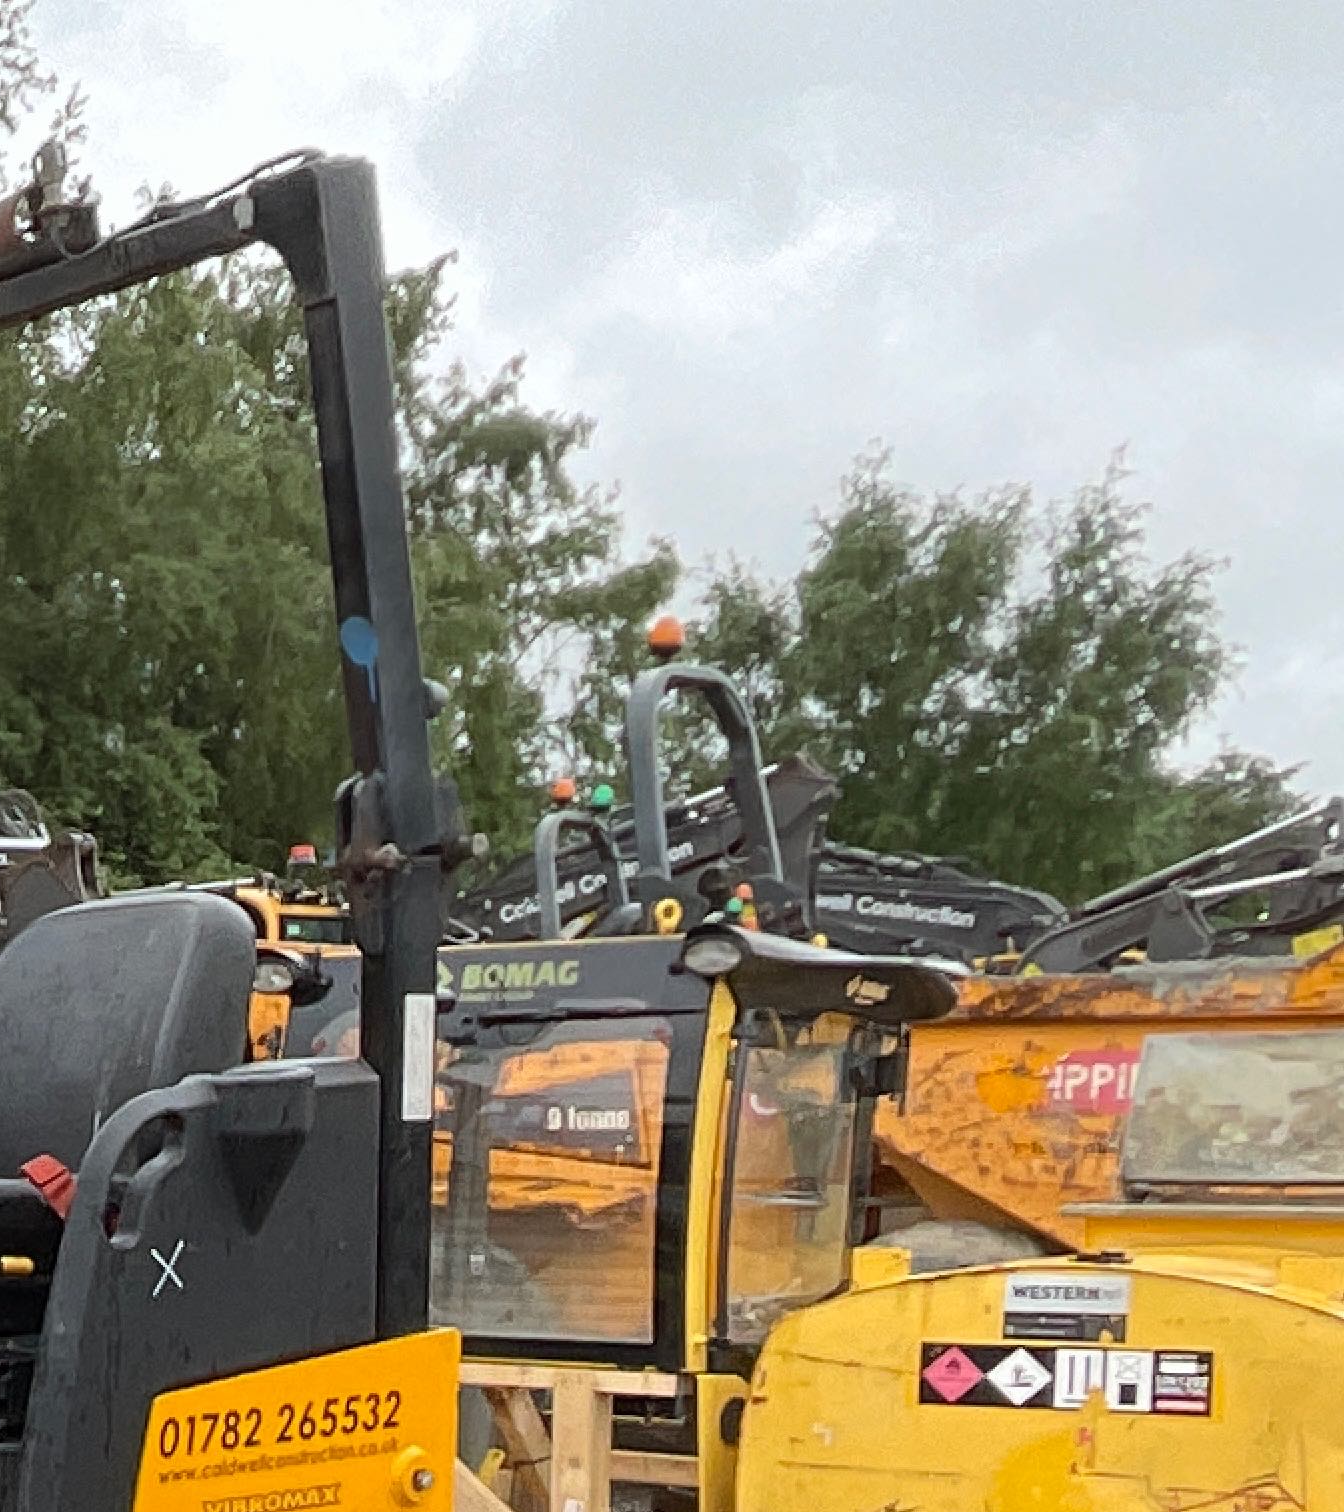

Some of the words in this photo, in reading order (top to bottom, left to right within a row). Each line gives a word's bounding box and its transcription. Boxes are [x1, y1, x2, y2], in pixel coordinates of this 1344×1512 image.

[460, 960, 580, 990] BOMAG
[159, 1407, 262, 1459] 01782
[276, 1390, 401, 1445] 265532
[158, 1437, 400, 1484] www.caldwellconstruction.co.uk
